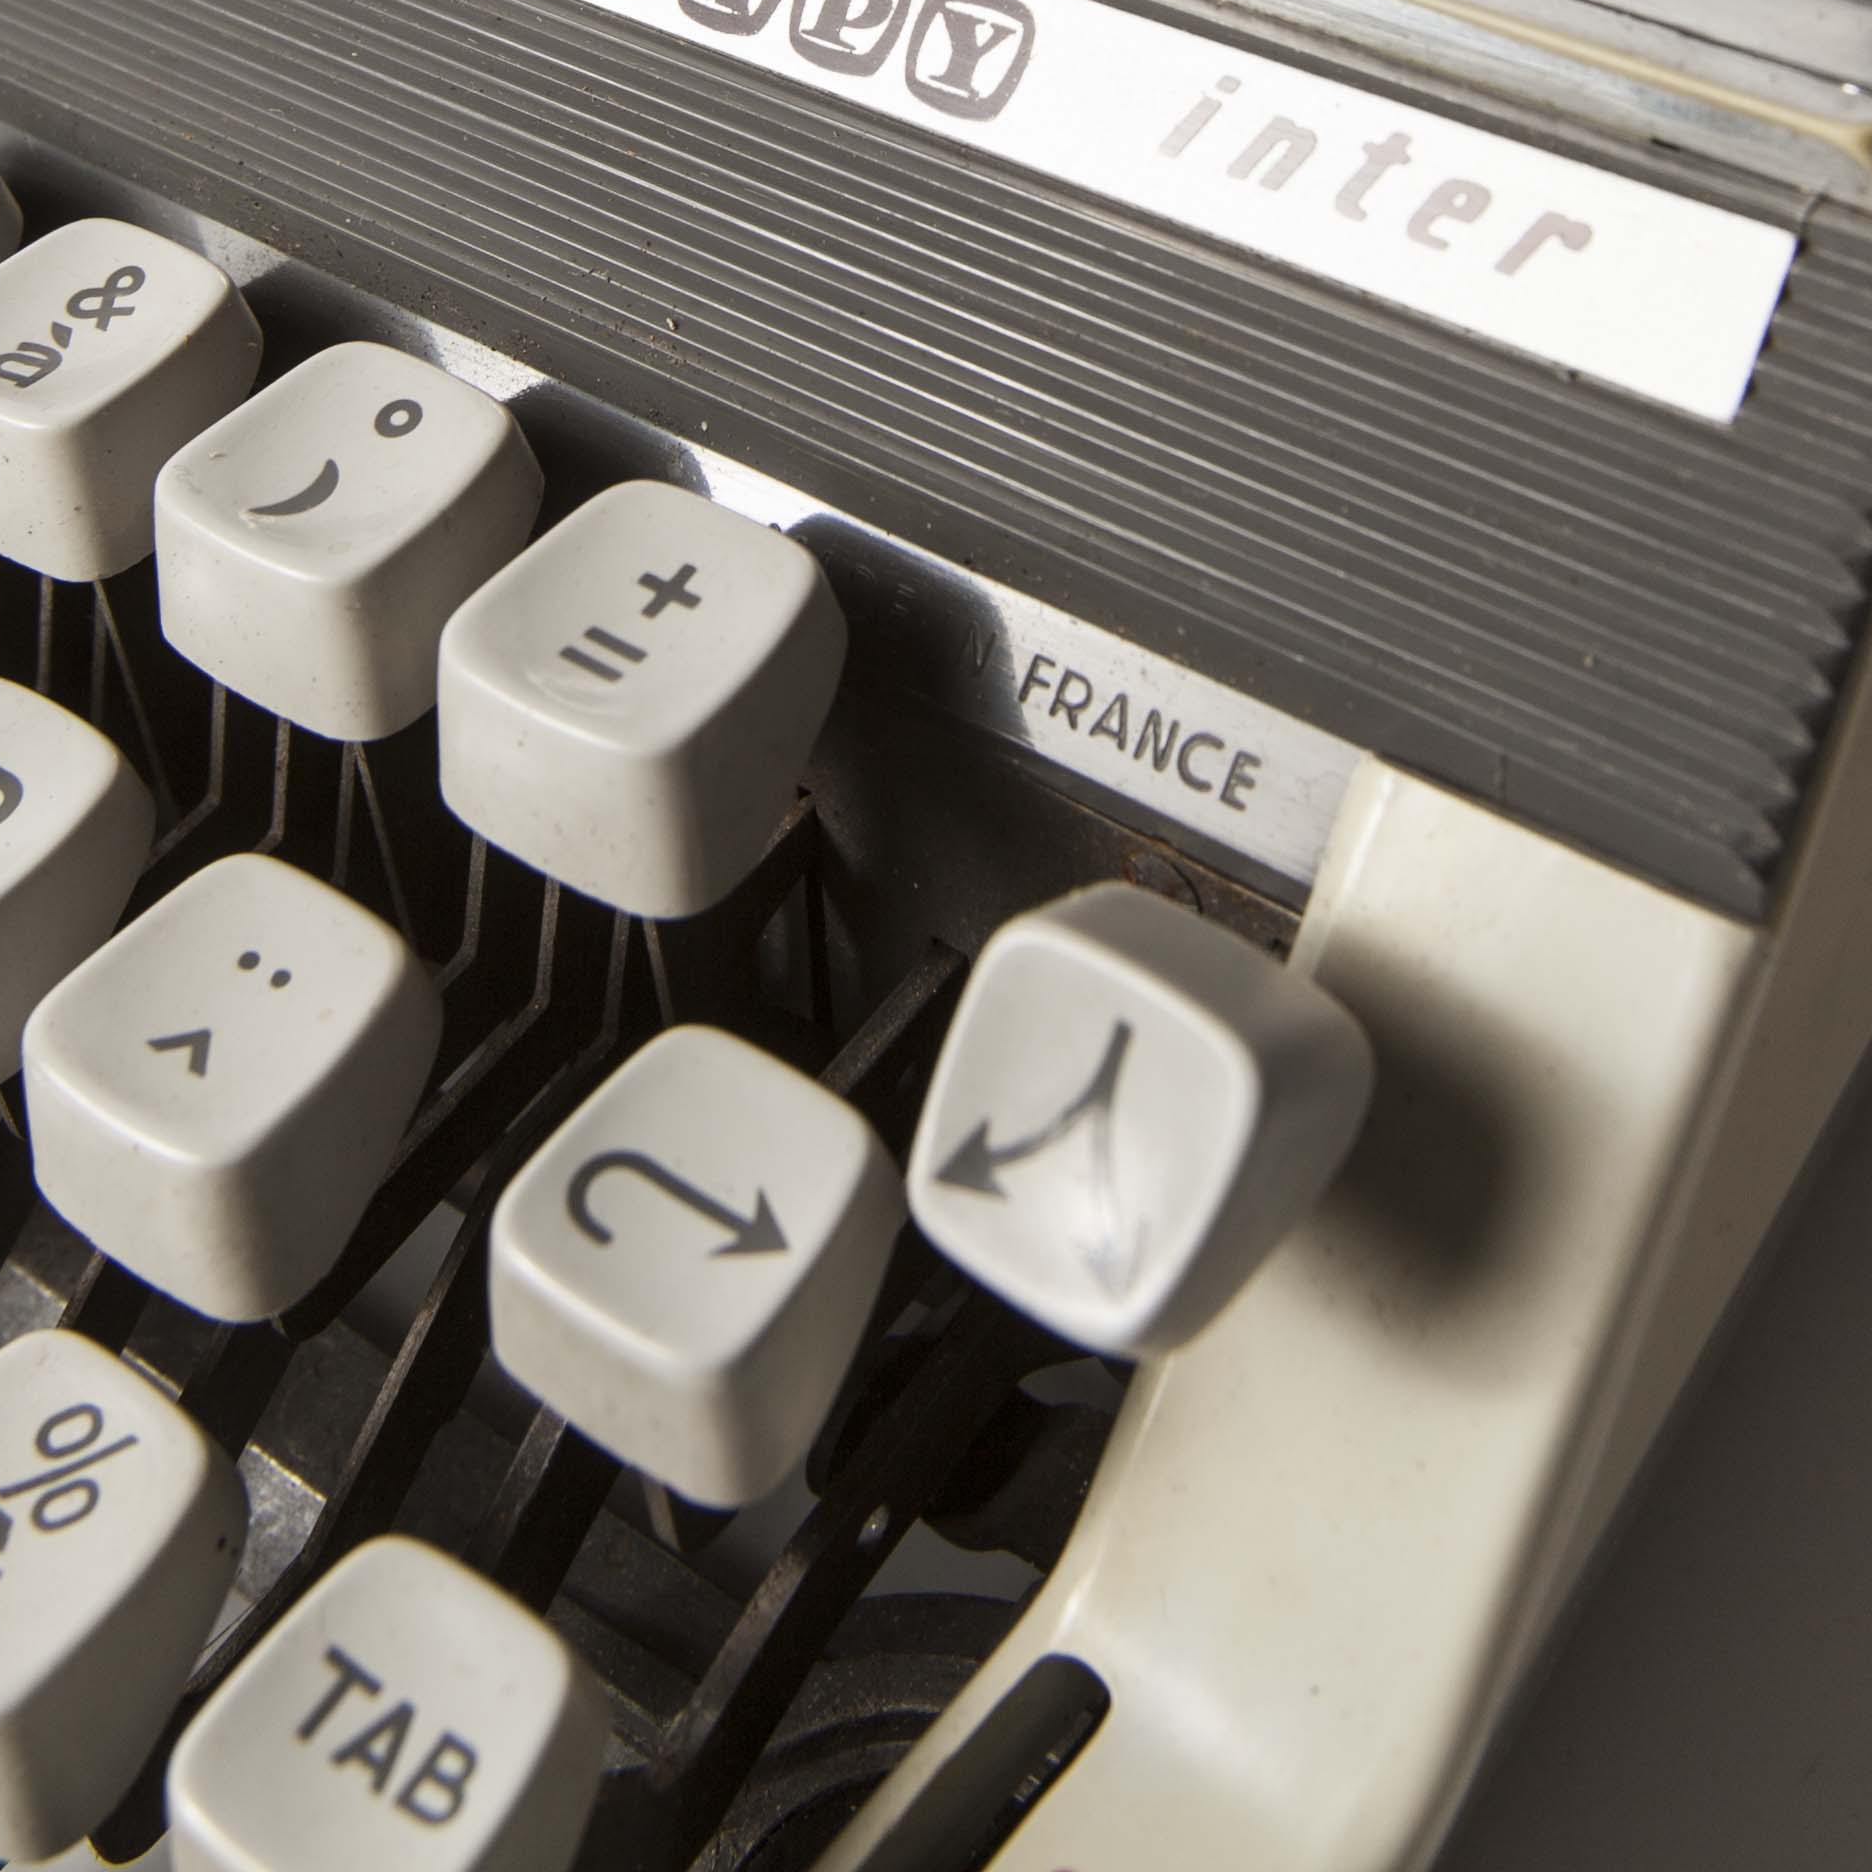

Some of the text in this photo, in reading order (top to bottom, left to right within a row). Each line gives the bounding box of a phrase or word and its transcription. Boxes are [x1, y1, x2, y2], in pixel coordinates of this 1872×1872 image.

[1160, 74, 1594, 277] inter
[66, 264, 146, 333] &
[637, 563, 702, 619] +
[558, 626, 648, 683] =
[1017, 652, 1263, 812] FRANCE
[296, 1644, 480, 1828] TAB
